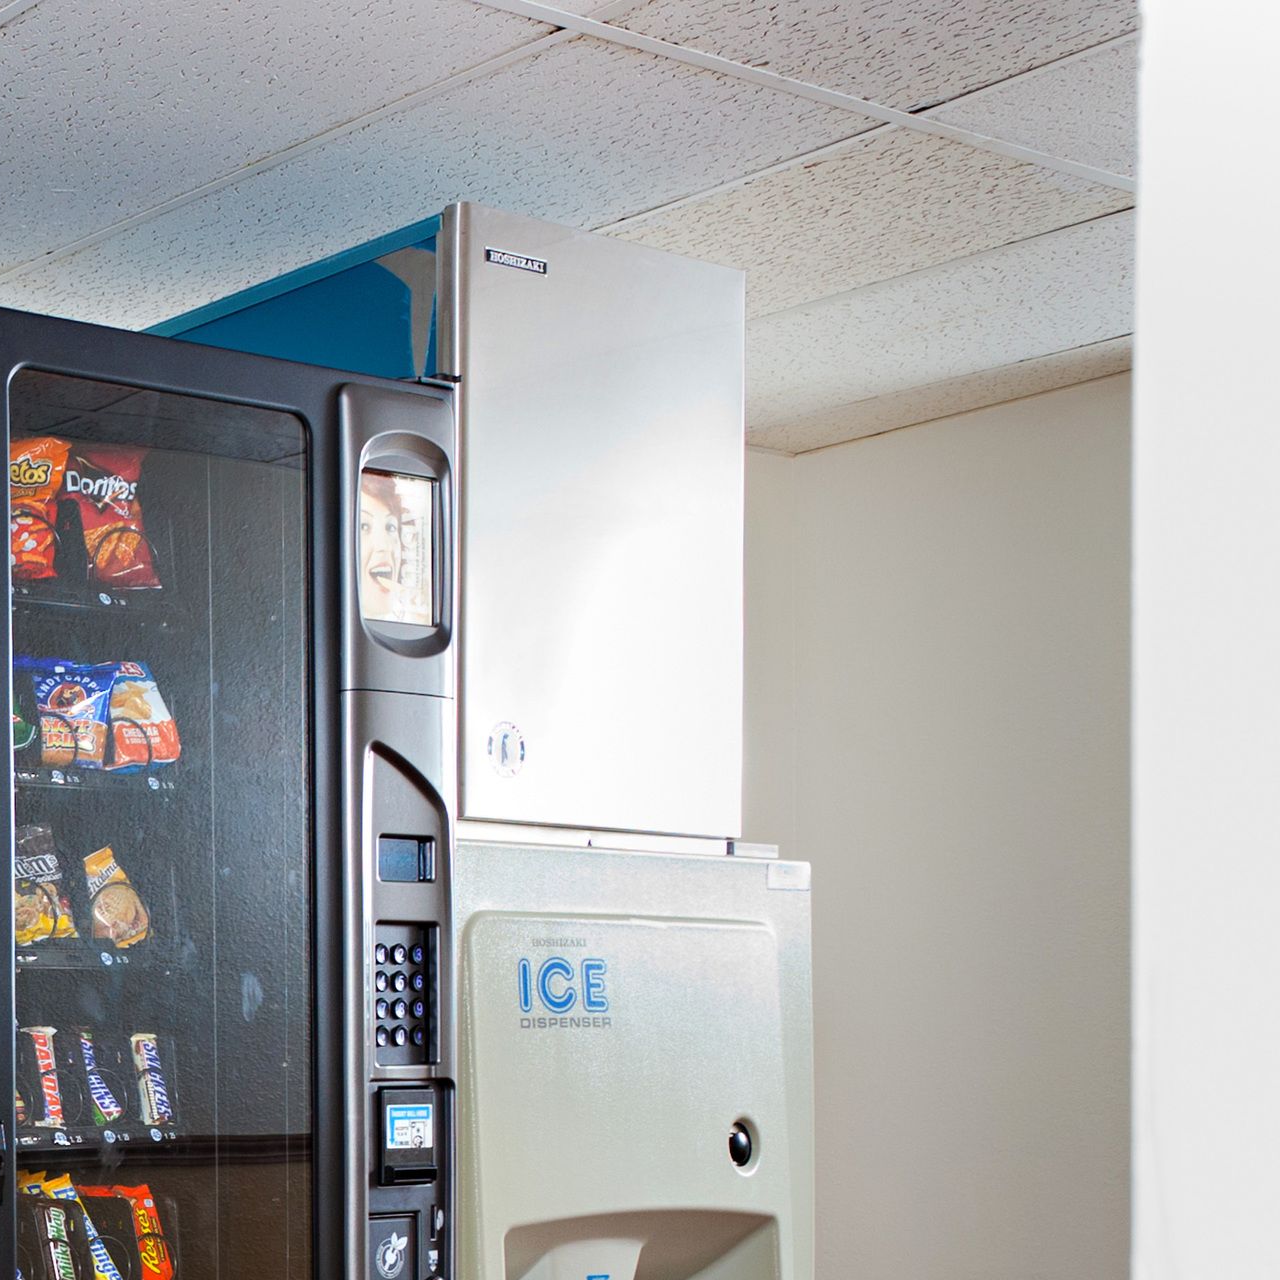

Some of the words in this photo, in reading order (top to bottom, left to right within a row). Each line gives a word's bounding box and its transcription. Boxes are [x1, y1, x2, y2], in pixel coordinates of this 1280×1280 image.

[490, 251, 545, 272] HOSHIZAKI
[10, 458, 49, 486] etos
[66, 470, 138, 500] Doritos
[532, 938, 587, 947] HOSHIZAKI
[518, 957, 609, 1014] ICE
[520, 1017, 612, 1029] DISPENSER
[48, 1207, 67, 1240] Way
[135, 1207, 161, 1275] Reese's
